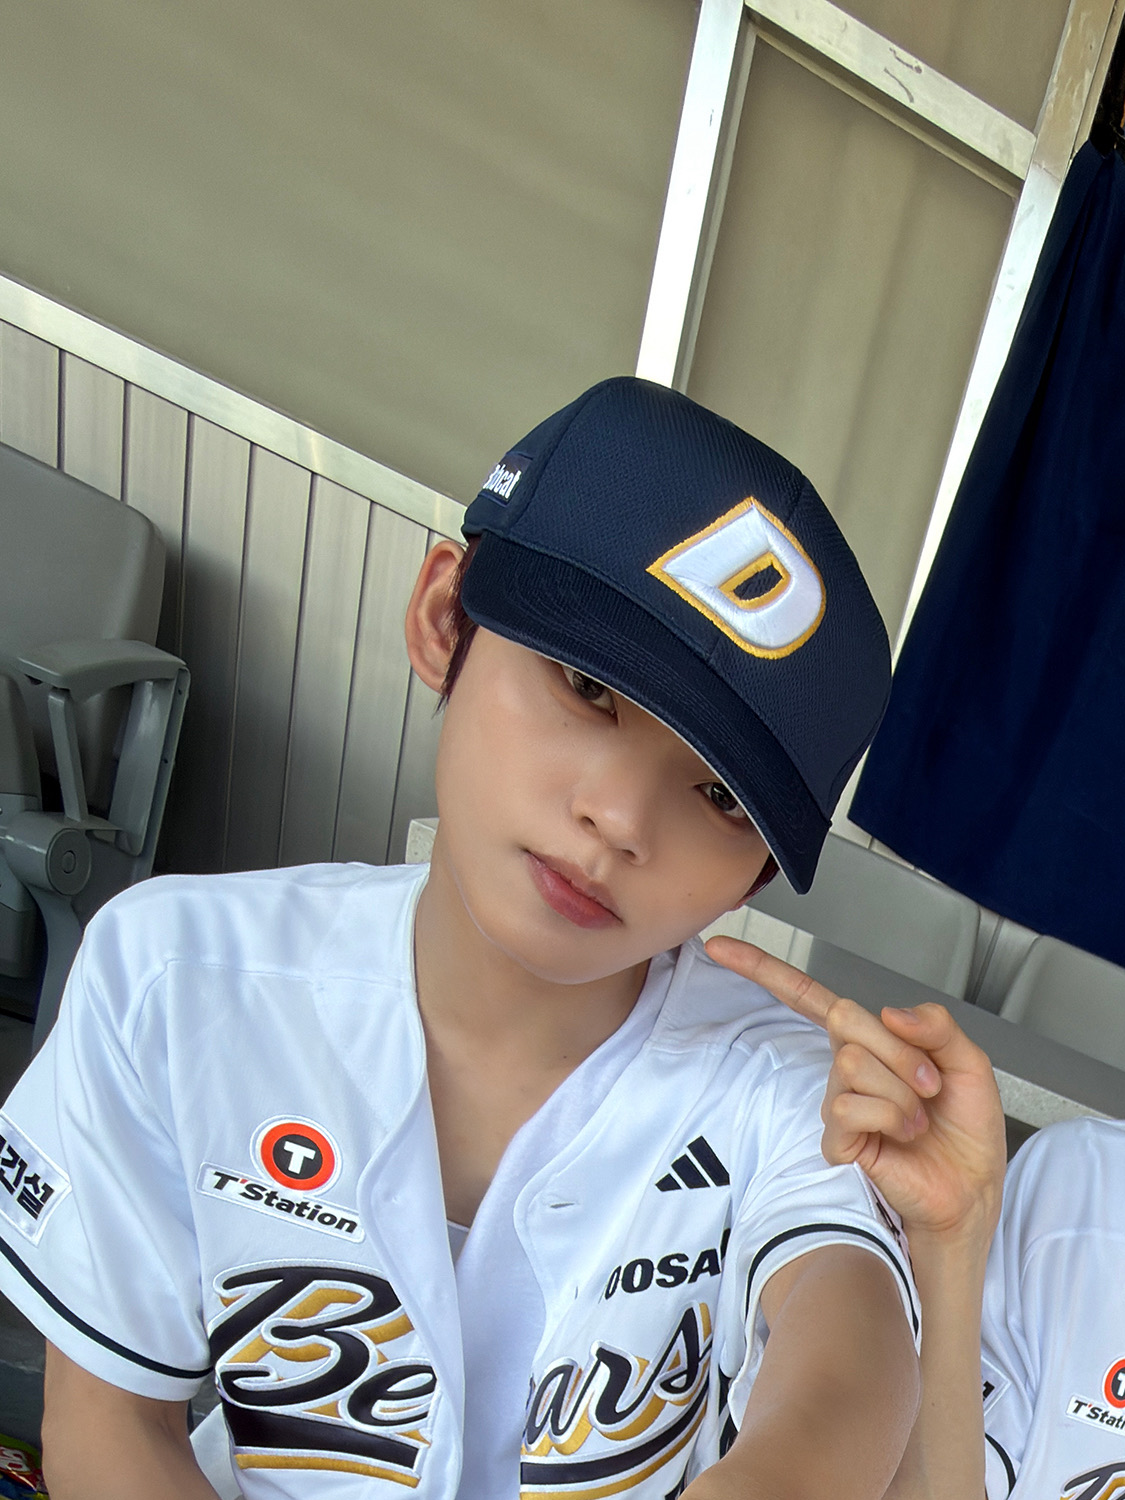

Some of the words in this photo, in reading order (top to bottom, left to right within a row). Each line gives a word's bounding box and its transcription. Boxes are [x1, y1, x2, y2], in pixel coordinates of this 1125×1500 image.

[646, 496, 827, 661] D
[0, 1133, 55, 1221] 건설
[283, 1140, 316, 1175] T
[212, 1171, 359, 1234] T'Station
[597, 1227, 732, 1305] OOSA
